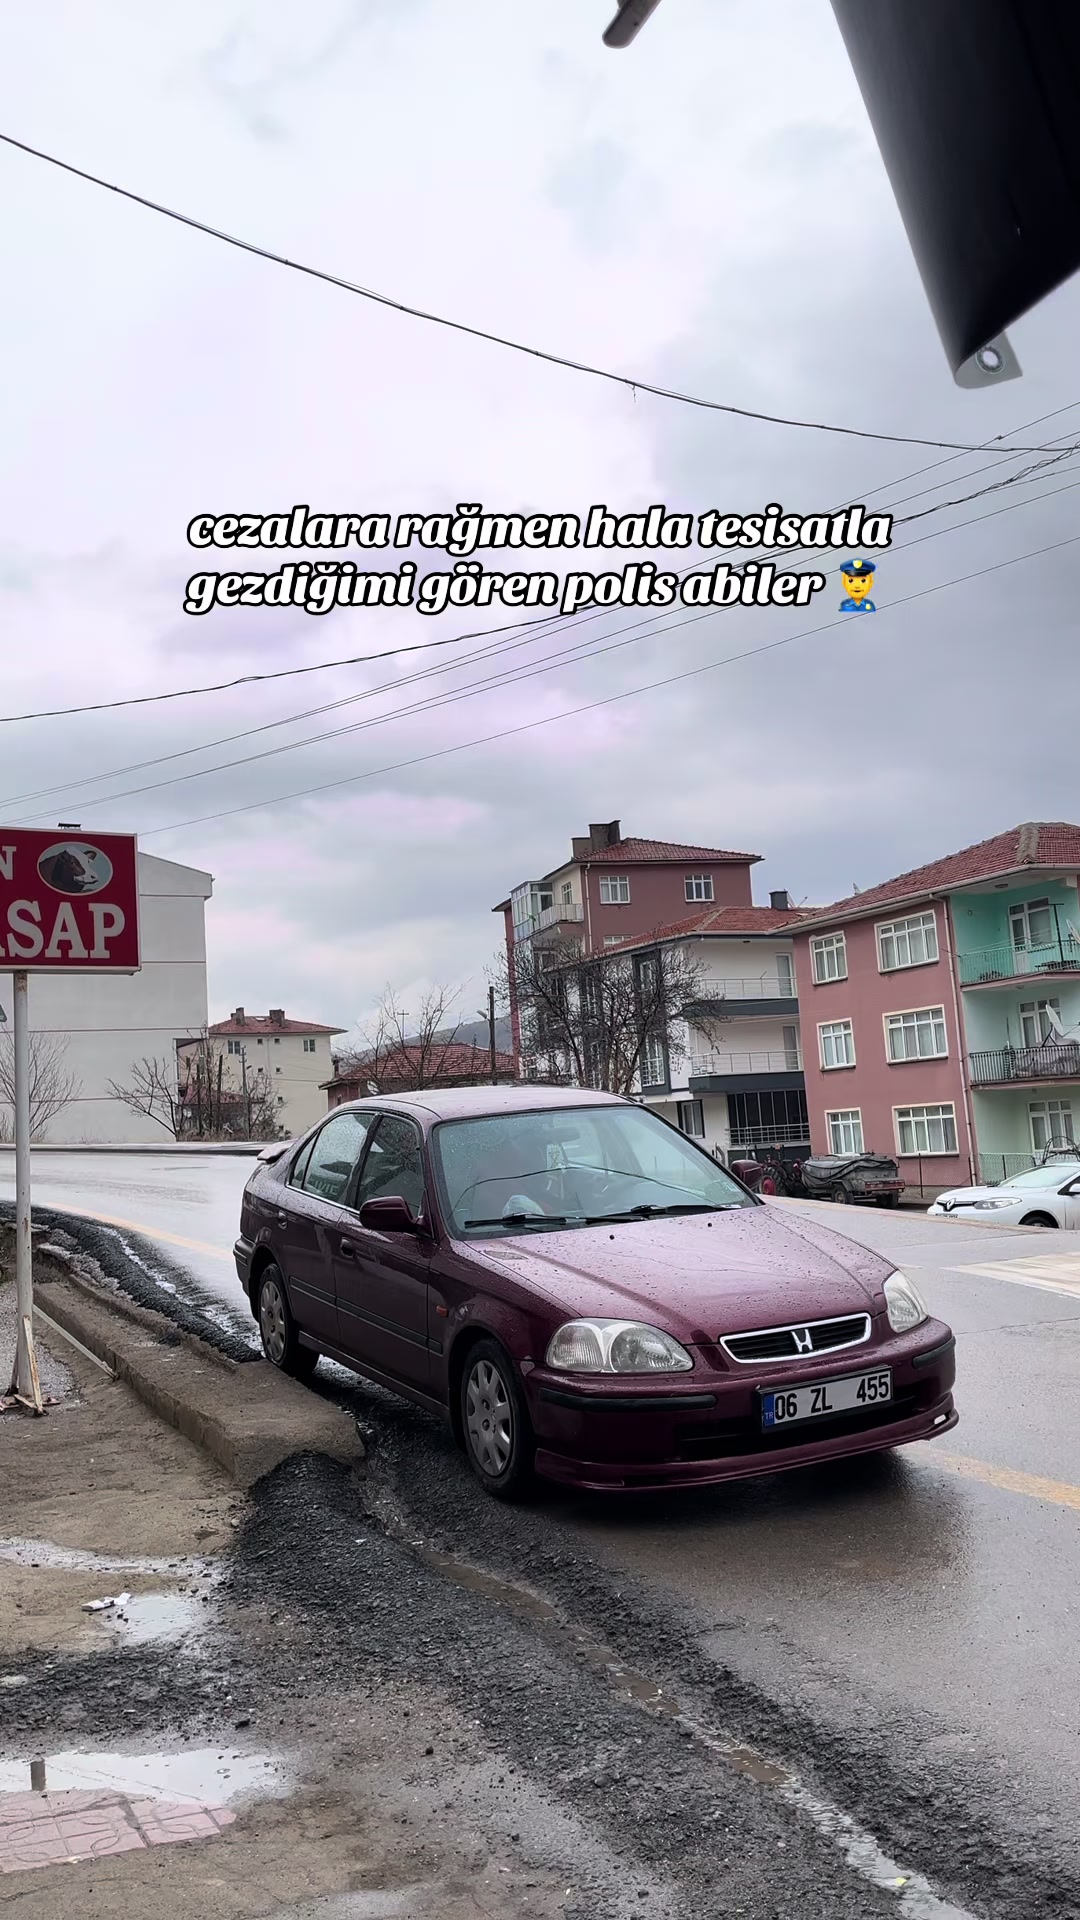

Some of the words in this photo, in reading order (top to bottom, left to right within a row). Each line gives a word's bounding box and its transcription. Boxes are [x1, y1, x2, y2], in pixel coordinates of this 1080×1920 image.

[0, 899, 126, 959] SAP
[765, 1411, 774, 1420] TR
[775, 1393, 797, 1420] 06
[811, 1386, 832, 1413] ZL
[856, 1374, 889, 1402] 455
